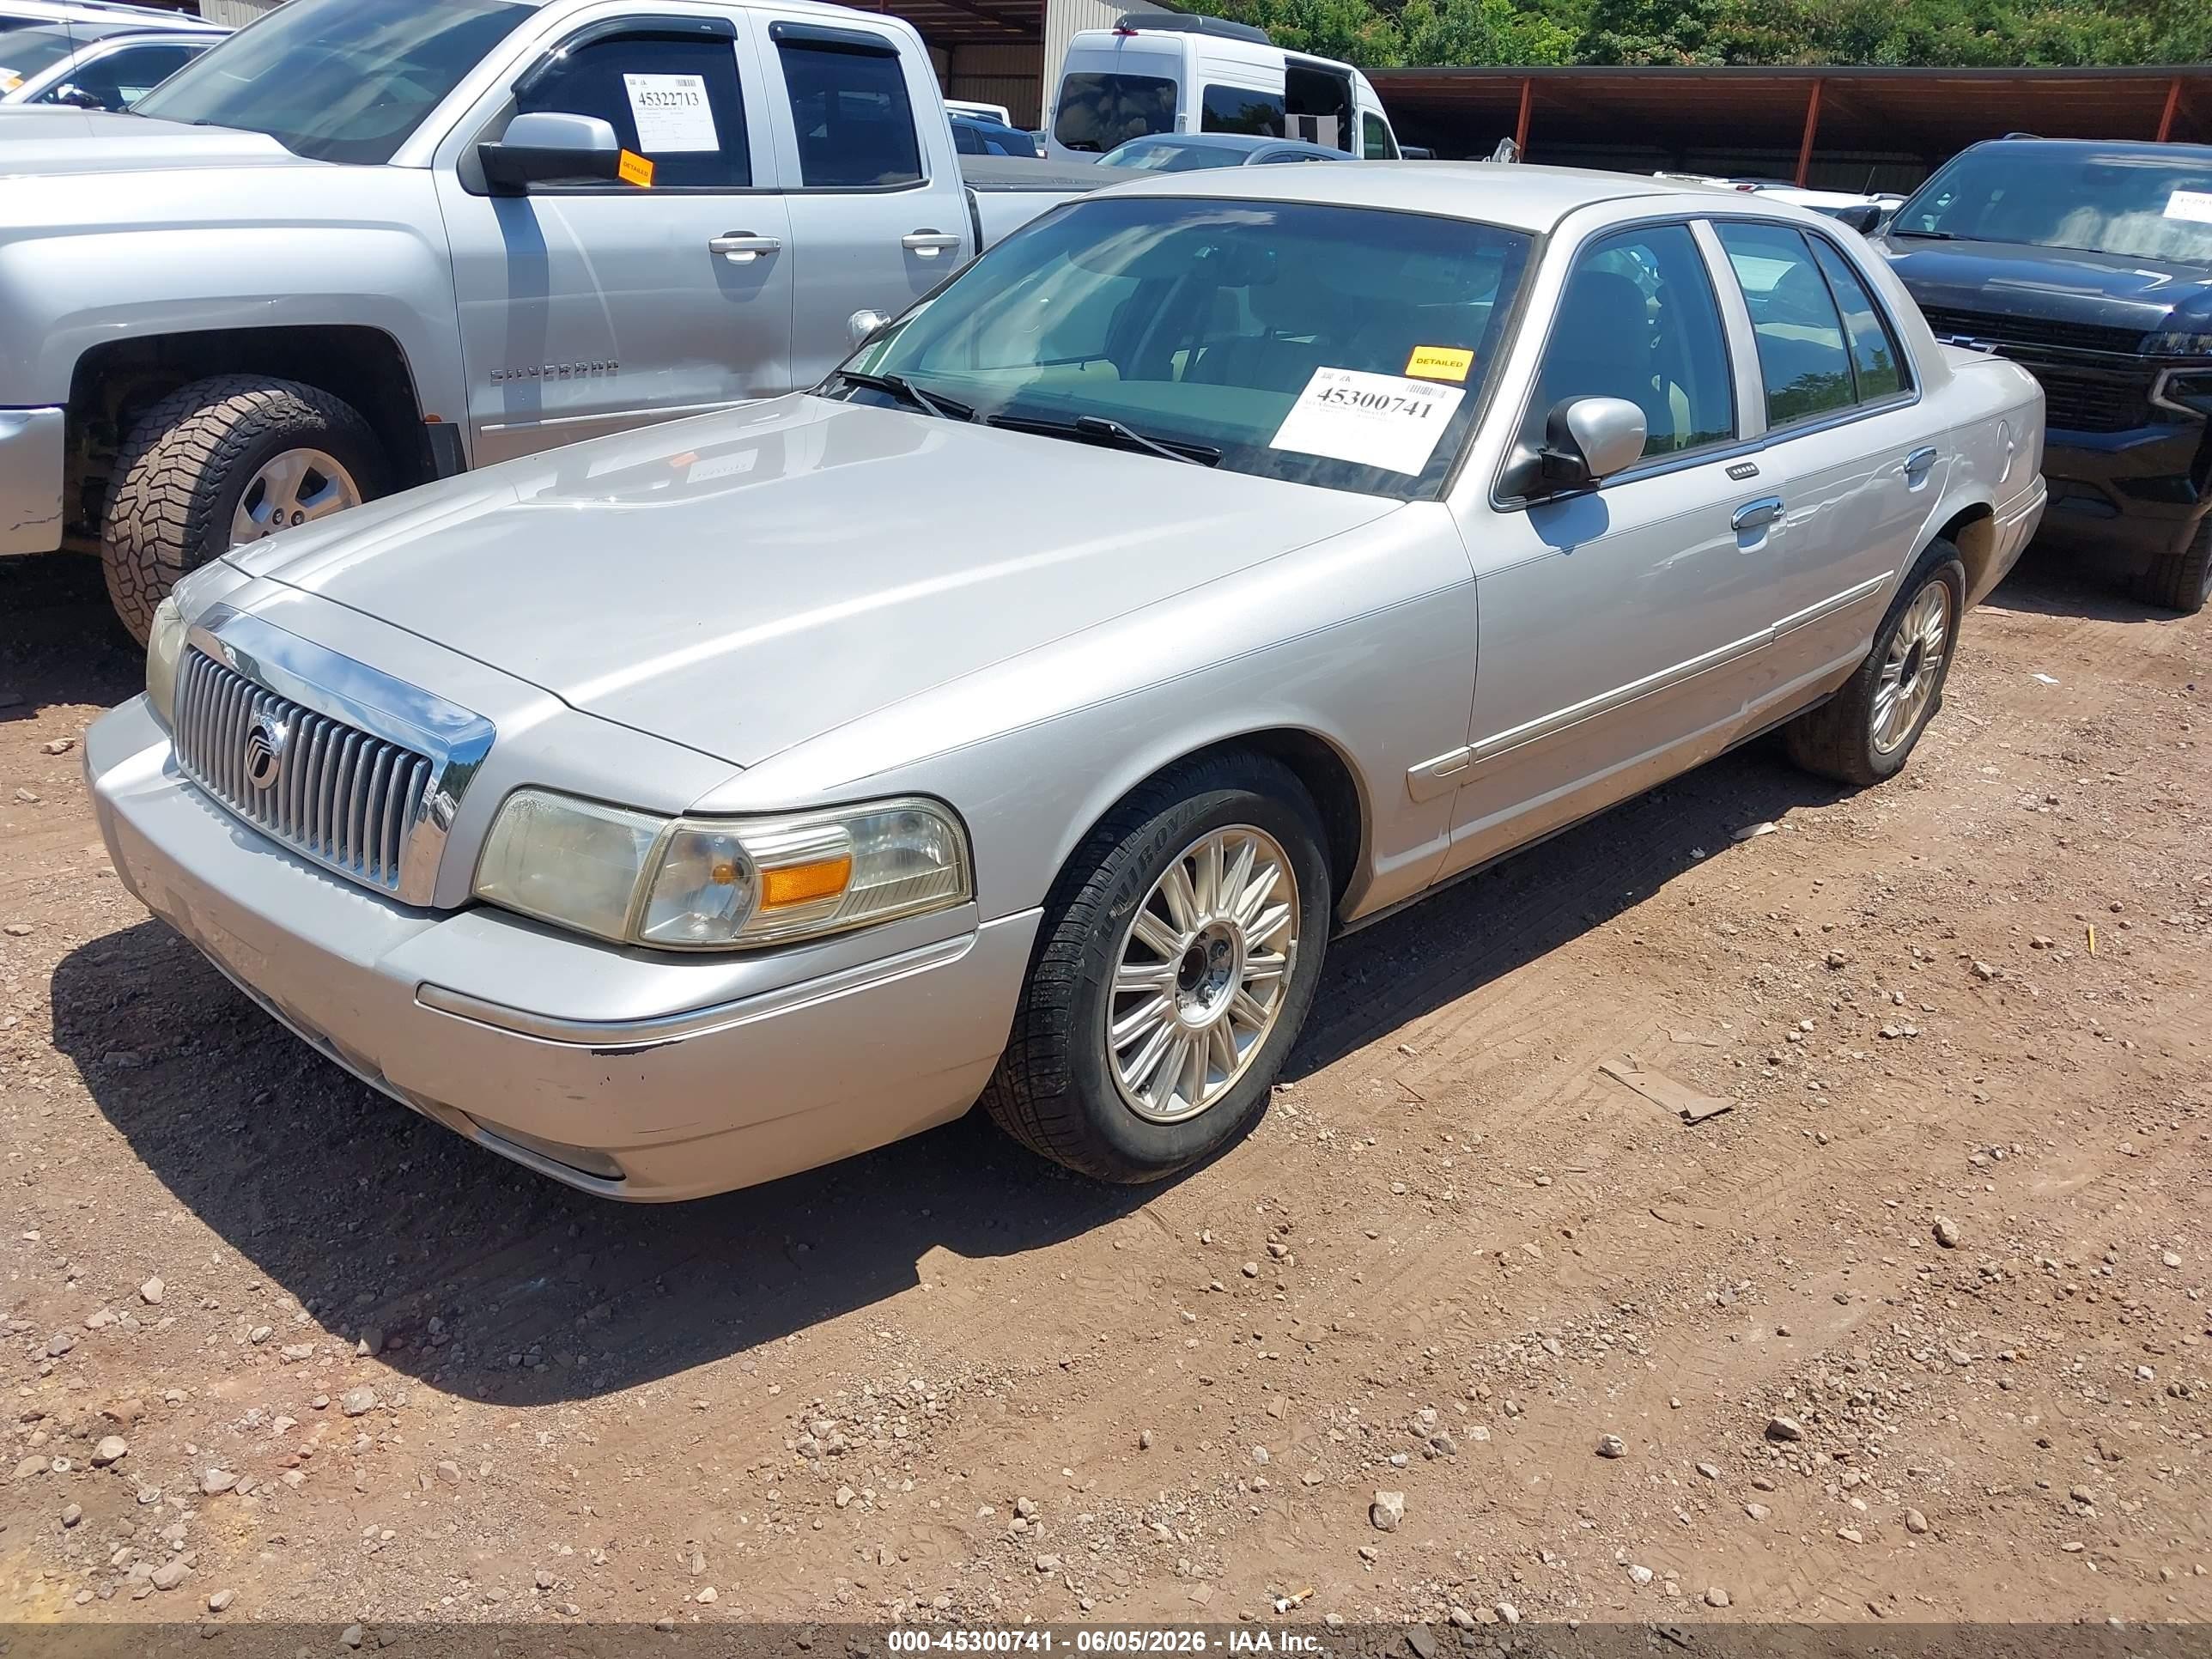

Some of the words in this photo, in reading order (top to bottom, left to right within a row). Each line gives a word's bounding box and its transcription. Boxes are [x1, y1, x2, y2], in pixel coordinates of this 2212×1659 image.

[638, 91, 699, 106] 45322713
[623, 161, 648, 176] DETAILED
[490, 360, 619, 382] SILVERADO
[1416, 357, 1463, 368] DETAILED
[1317, 387, 1433, 418] 45300741
[1099, 800, 1210, 941] UNIROYAL
